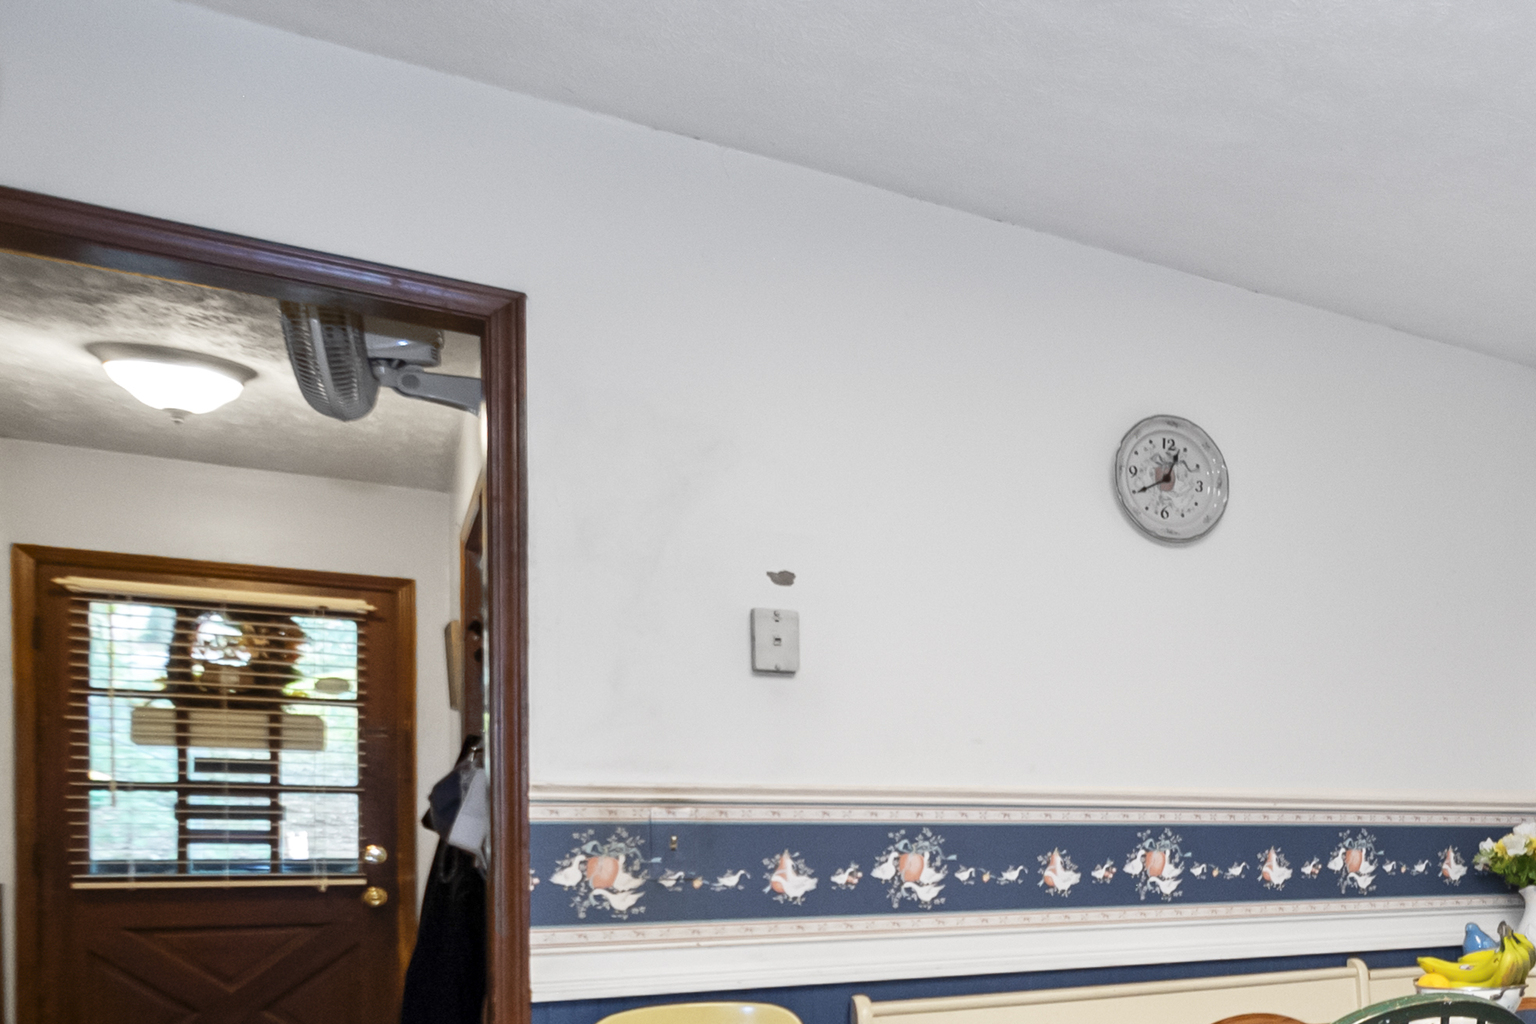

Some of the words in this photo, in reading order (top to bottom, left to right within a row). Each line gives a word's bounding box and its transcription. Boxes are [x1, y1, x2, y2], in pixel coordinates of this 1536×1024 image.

[1161, 437, 1177, 451] 12
[1129, 465, 1138, 477] 9
[1195, 480, 1204, 493] 3
[1160, 507, 1170, 519] 6
